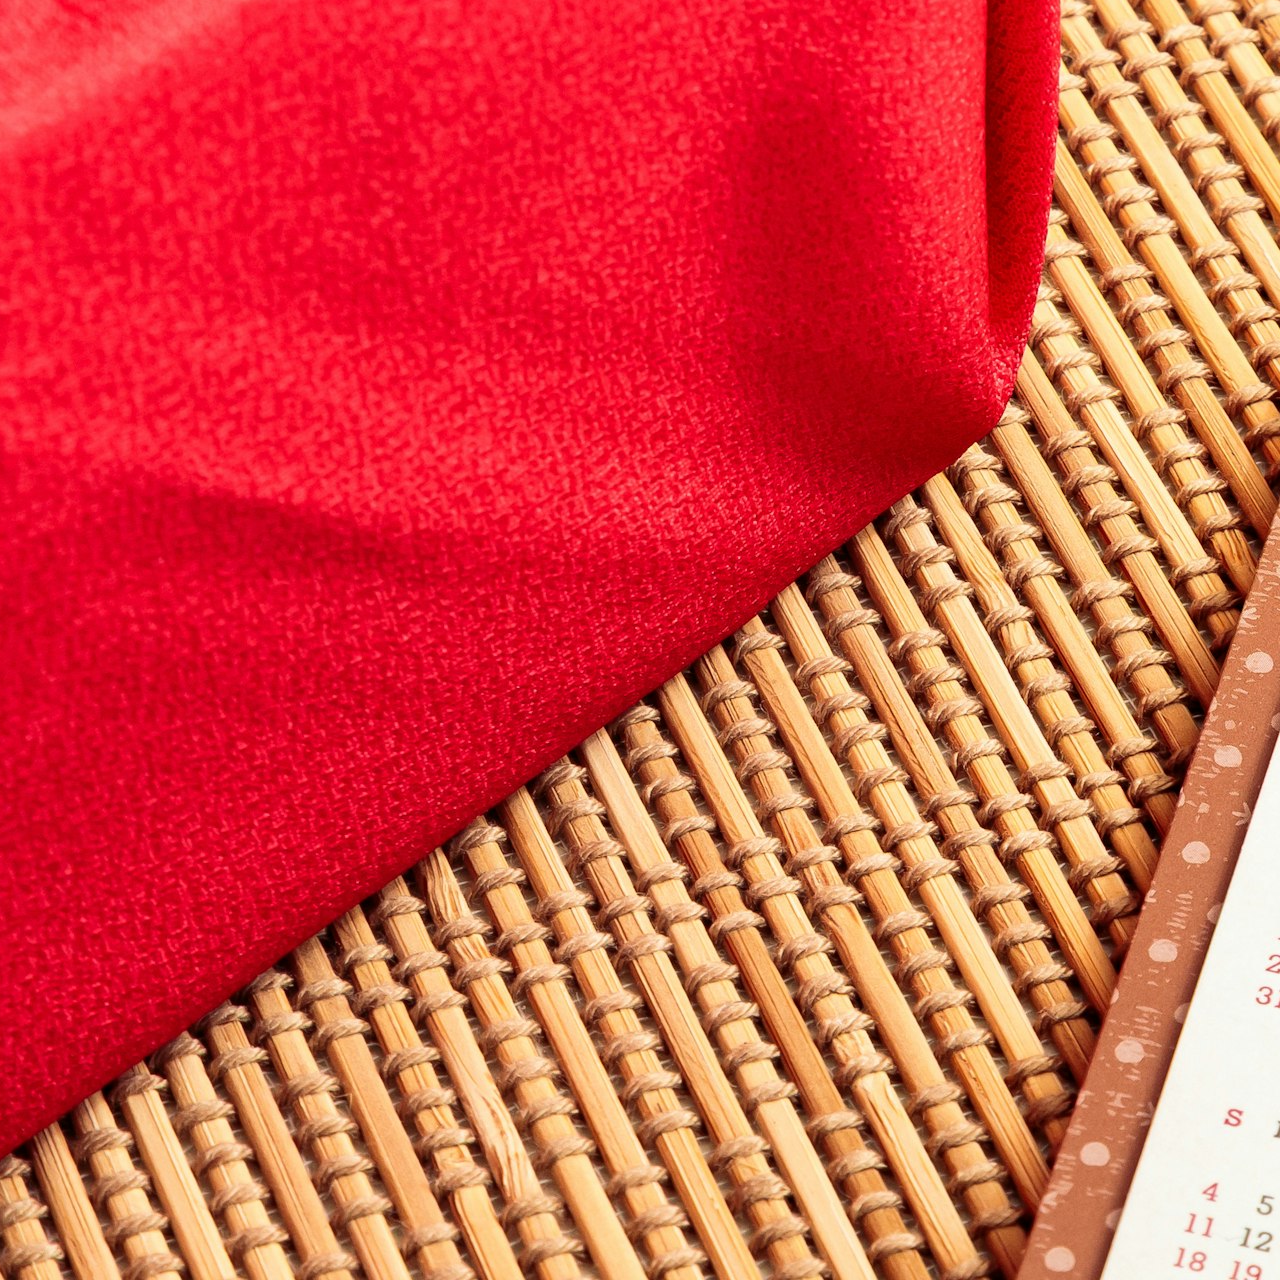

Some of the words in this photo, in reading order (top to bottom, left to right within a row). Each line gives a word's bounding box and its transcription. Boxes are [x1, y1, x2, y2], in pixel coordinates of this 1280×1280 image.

[1223, 1108, 1244, 1128] S
[1201, 1182, 1219, 1203] 4
[1255, 1194, 1275, 1216] 5
[1184, 1212, 1214, 1238] 11
[1239, 1226, 1275, 1253] 12
[1173, 1247, 1208, 1273] 18
[1227, 1260, 1263, 1280] 19
